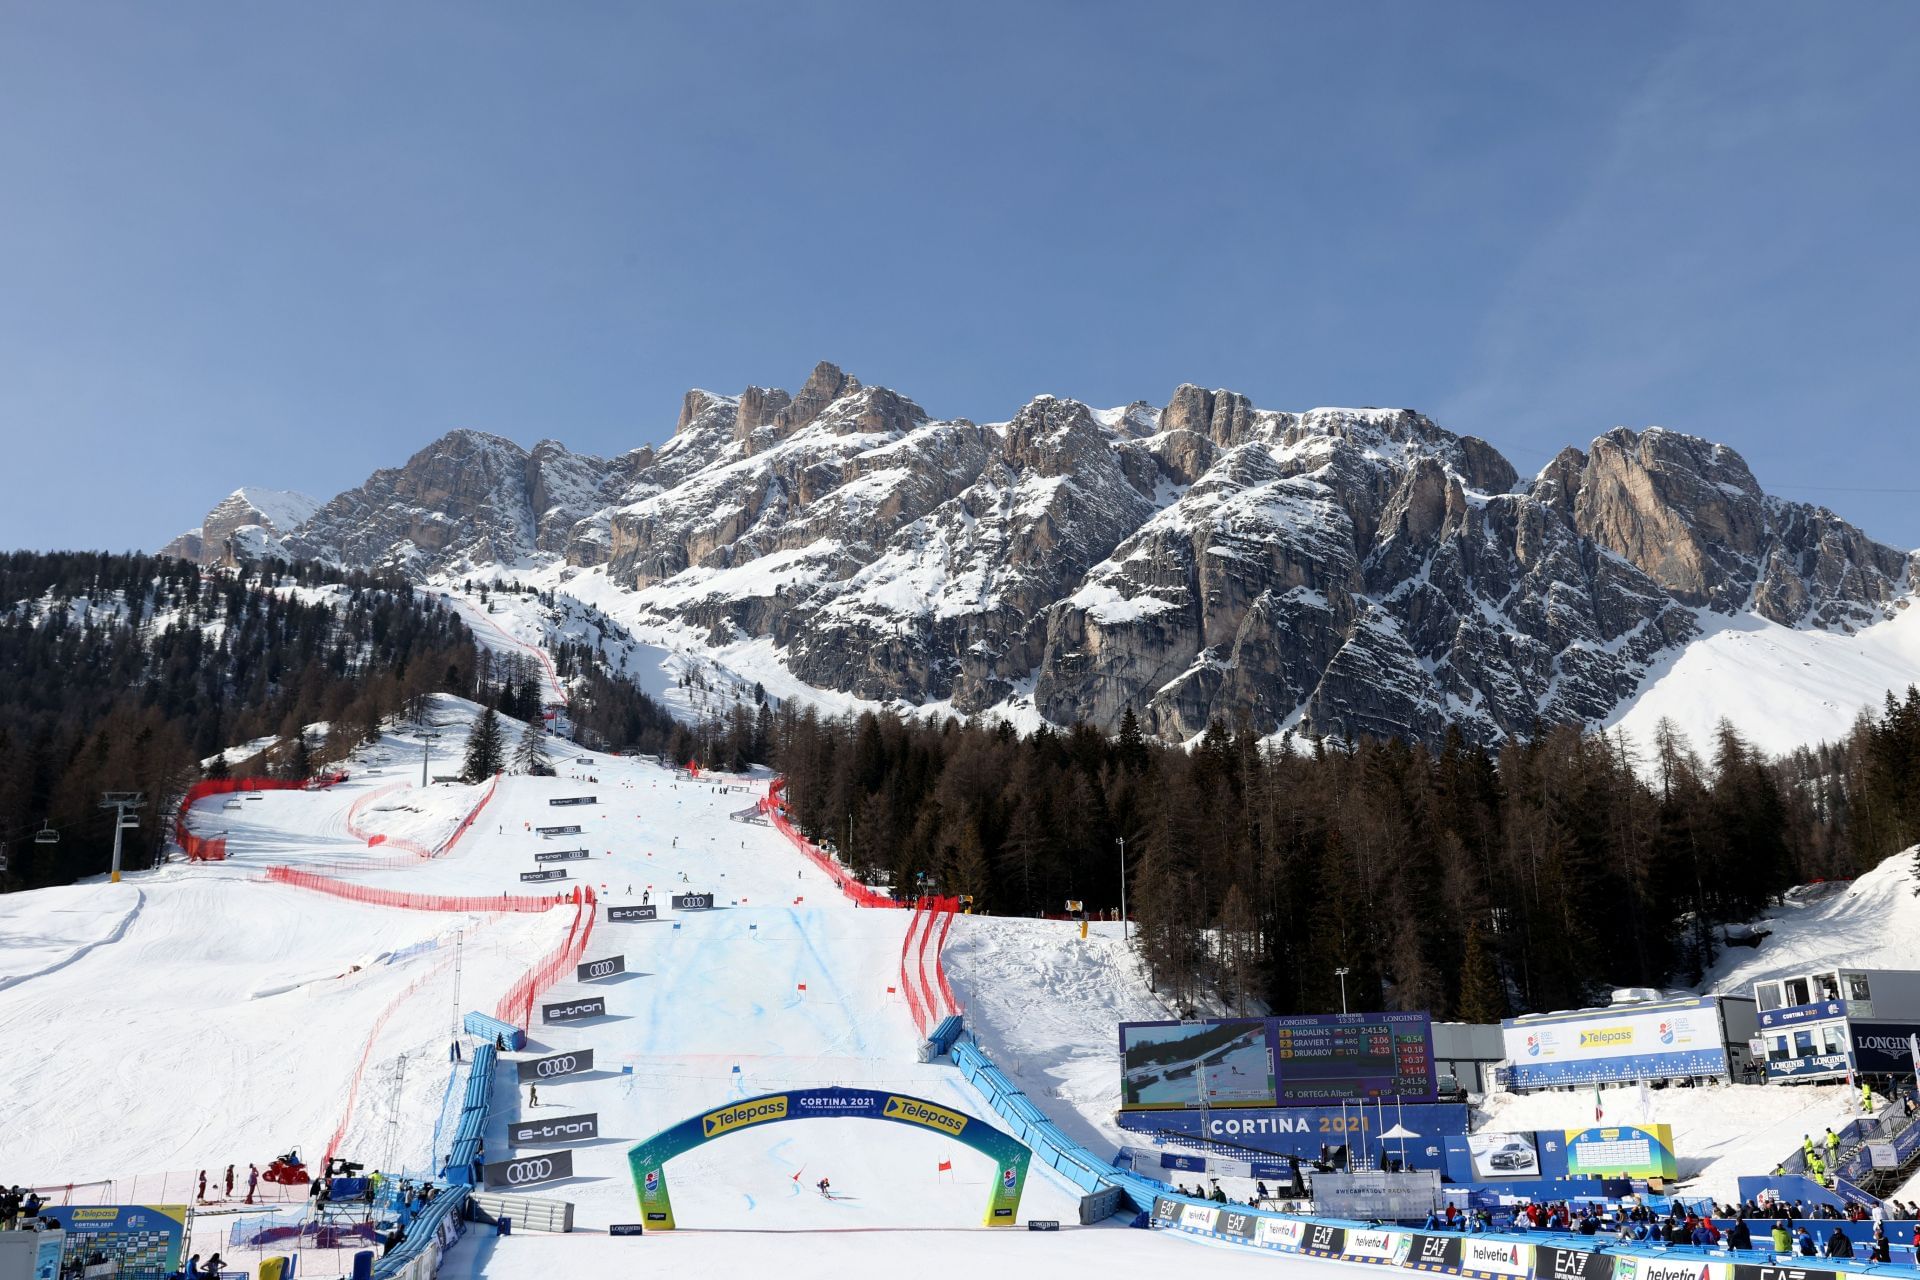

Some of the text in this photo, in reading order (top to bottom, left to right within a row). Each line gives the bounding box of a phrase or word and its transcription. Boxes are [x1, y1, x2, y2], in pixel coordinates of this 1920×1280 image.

[612, 909, 655, 918] e-tron
[549, 1003, 602, 1018] e-tron
[1279, 1018, 1318, 1026] LONGINES
[1382, 1015, 1423, 1023] LONGINES
[1292, 1028, 1324, 1037] HADALIN
[1361, 1026, 1388, 1035] 2:41.56
[1589, 1030, 1632, 1044] Telepass
[1293, 1039, 1324, 1047] GRAVIER
[1294, 1049, 1332, 1057] DRUKAROV
[1771, 1059, 1805, 1070] LONGINES
[1297, 1090, 1329, 1098] ORTEGA
[1331, 1089, 1354, 1097] Albert
[800, 1097, 875, 1106] CORTINA 2021
[716, 1102, 785, 1127] Telepass
[900, 1101, 963, 1130] Telepass
[517, 1121, 593, 1140] e-tron
[1210, 1116, 1369, 1134] CORTINA 2021
[81, 1209, 116, 1219] Telepass
[1160, 1200, 1177, 1215] EA7
[1227, 1213, 1246, 1231] EA7
[1312, 1226, 1334, 1245] EA7
[1355, 1234, 1381, 1248] helvetia
[1422, 1237, 1450, 1257] EA7
[1473, 1244, 1508, 1263] helvetia
[1555, 1249, 1589, 1275] EA7
